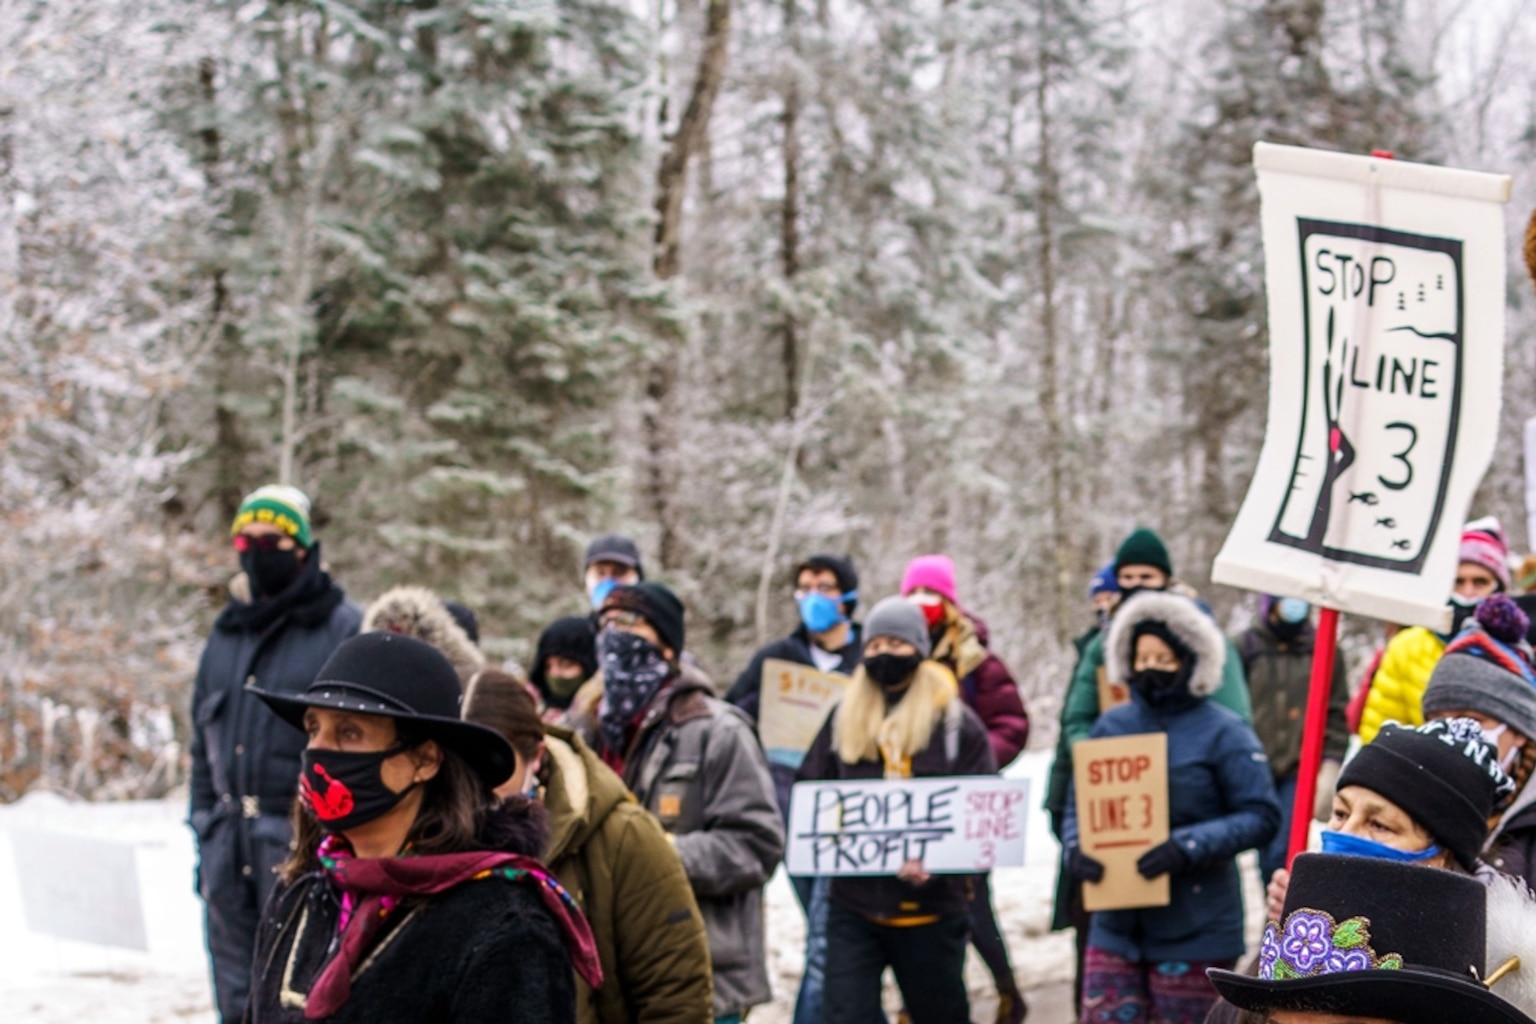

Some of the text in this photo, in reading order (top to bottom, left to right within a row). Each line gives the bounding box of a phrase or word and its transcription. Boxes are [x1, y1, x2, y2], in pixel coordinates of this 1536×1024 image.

[1315, 248, 1397, 308] STOP
[1350, 344, 1440, 399] LINE
[1376, 420, 1420, 491] 3
[1087, 755, 1152, 785] STOP
[812, 784, 960, 833] PEOPLE
[965, 788, 1025, 813] STOP
[1088, 793, 1153, 834] LINE 3
[964, 813, 1021, 841] LINE
[811, 833, 943, 871] PROFIT
[974, 841, 997, 870] 3
